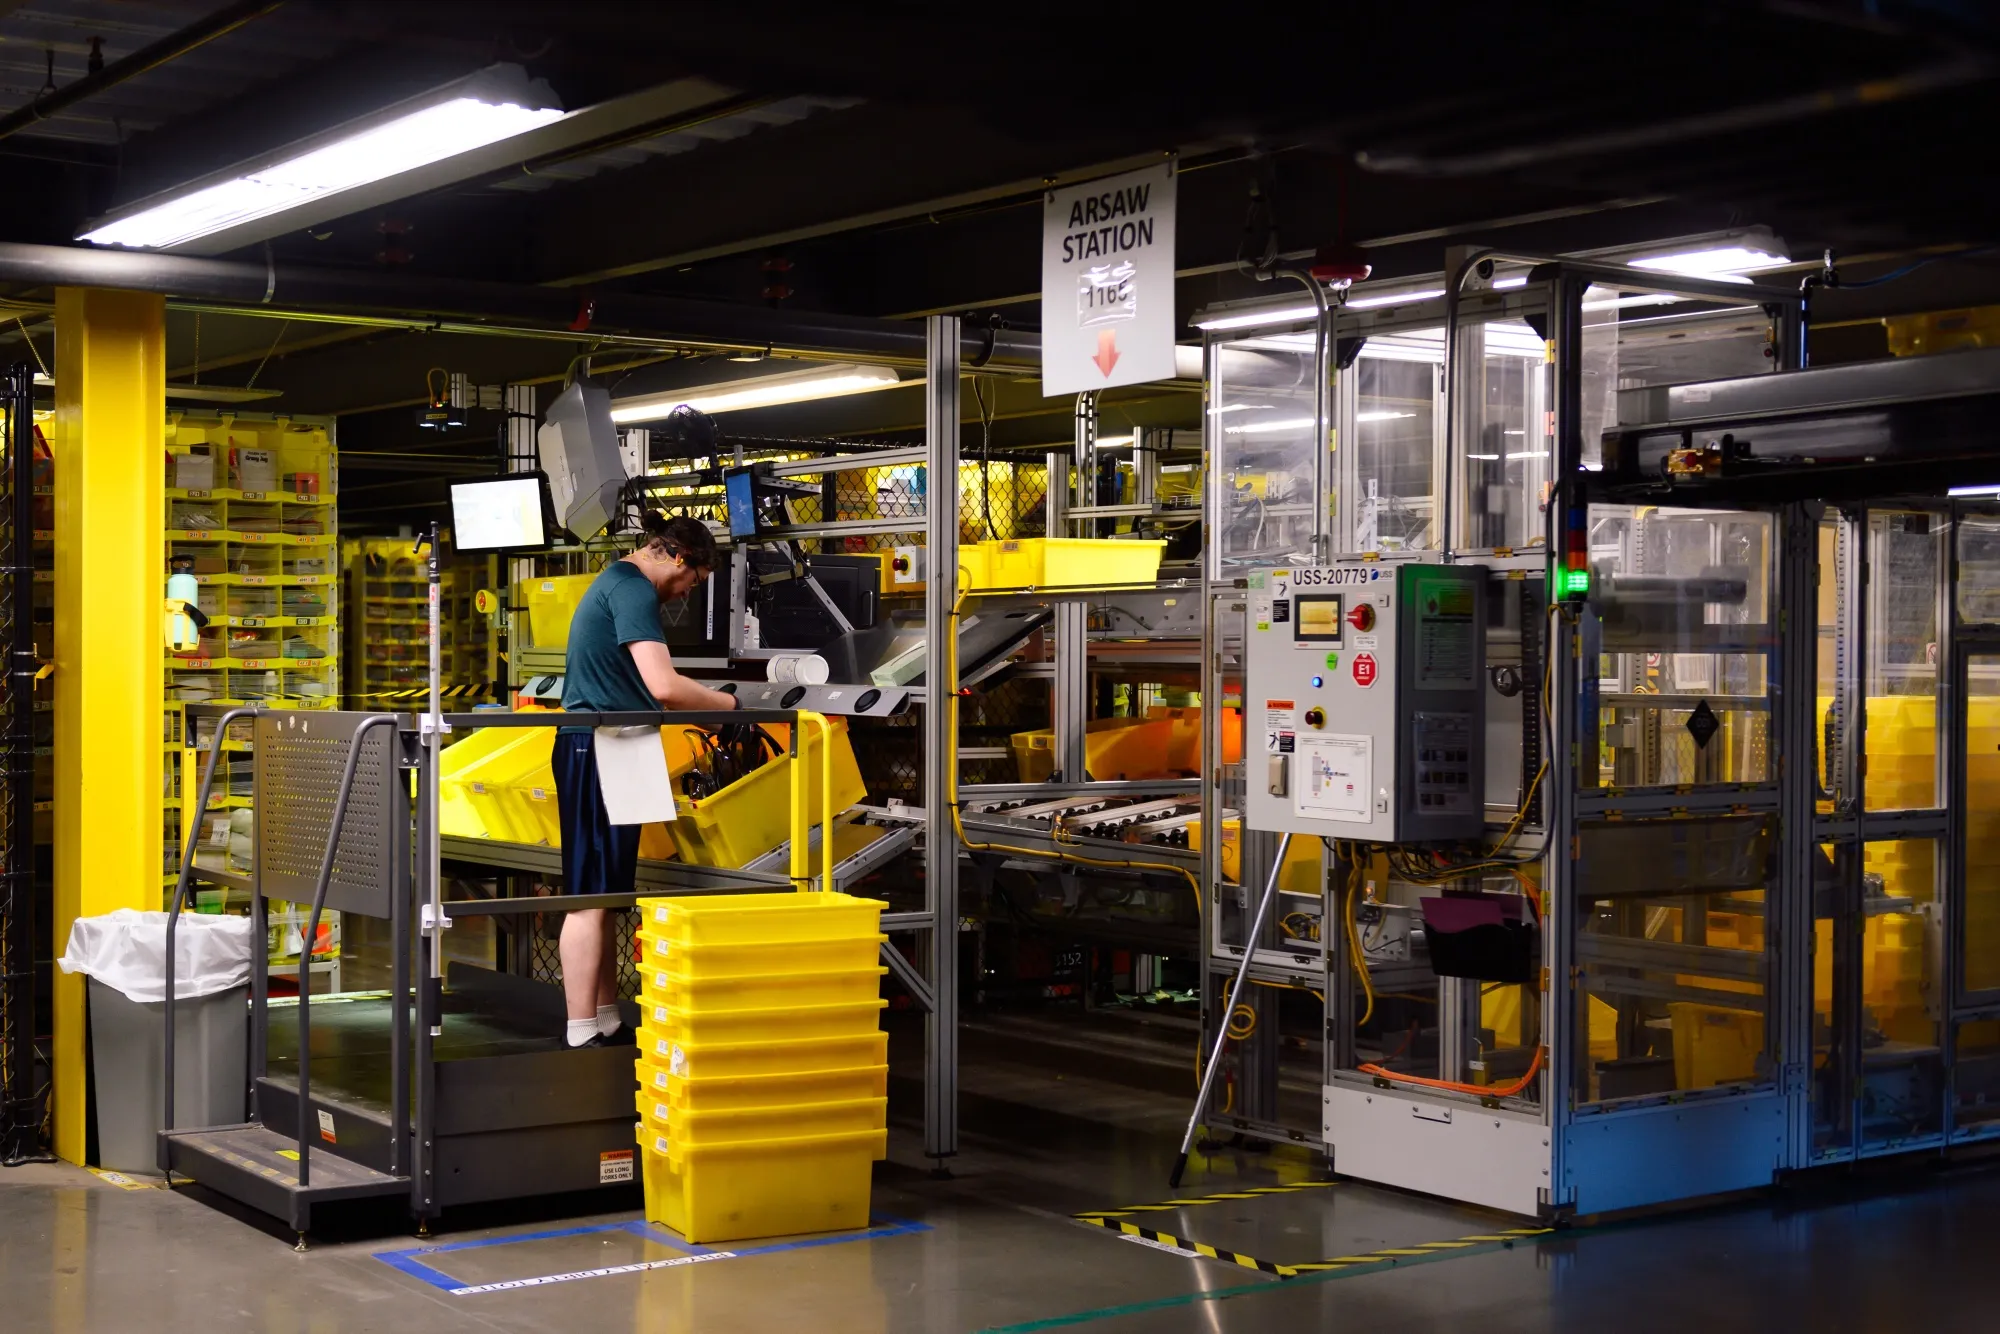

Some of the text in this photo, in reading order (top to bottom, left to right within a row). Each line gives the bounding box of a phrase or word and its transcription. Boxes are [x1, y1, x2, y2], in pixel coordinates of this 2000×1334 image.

[1068, 183, 1151, 229] ARSAW
[1062, 217, 1153, 263] STATION
[1293, 568, 1368, 586] USS-20779
[1379, 570, 1393, 578] USS
[1358, 664, 1370, 674] E1
